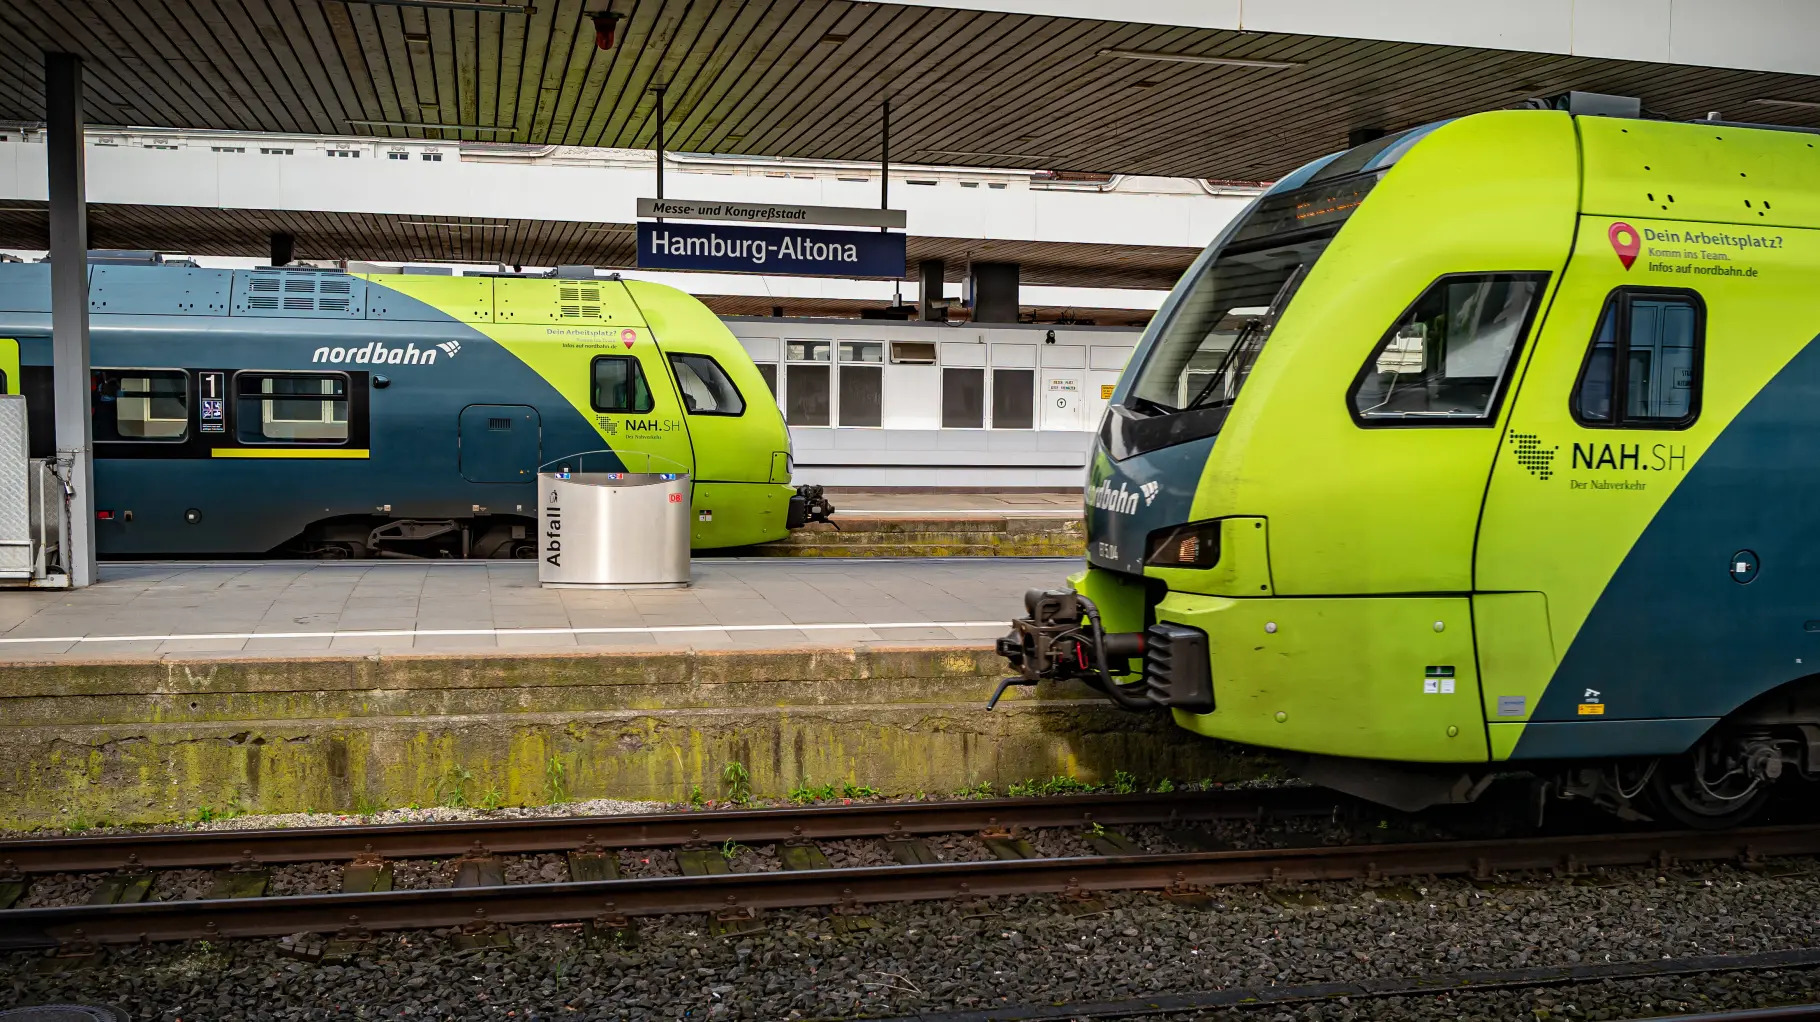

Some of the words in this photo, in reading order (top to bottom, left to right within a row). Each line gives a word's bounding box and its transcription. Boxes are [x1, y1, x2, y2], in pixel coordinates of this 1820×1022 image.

[653, 202, 695, 215] Messe-
[698, 205, 721, 216] und
[724, 206, 807, 220] Kongreßstadt
[651, 230, 858, 264] Hamburg-Altona
[1644, 228, 1680, 243] Dein
[1684, 231, 1783, 250] Arbeitsplatz?
[1648, 247, 1681, 258] Komm
[1684, 249, 1698, 260] ins
[1649, 262, 1673, 273] Infos
[1675, 263, 1692, 274] auf
[1694, 265, 1758, 278] nordbahn.de
[566, 329, 617, 337] Arbeitsplatz?
[312, 341, 437, 365] nordbahn
[205, 374, 215, 397] 1
[625, 419, 680, 431] NAH.SH
[1572, 442, 1686, 471] NAH.SH
[1570, 480, 1588, 490] Der
[1590, 479, 1646, 491] Nahverkehr
[670, 494, 681, 502] DB
[546, 507, 561, 567] Abfall
